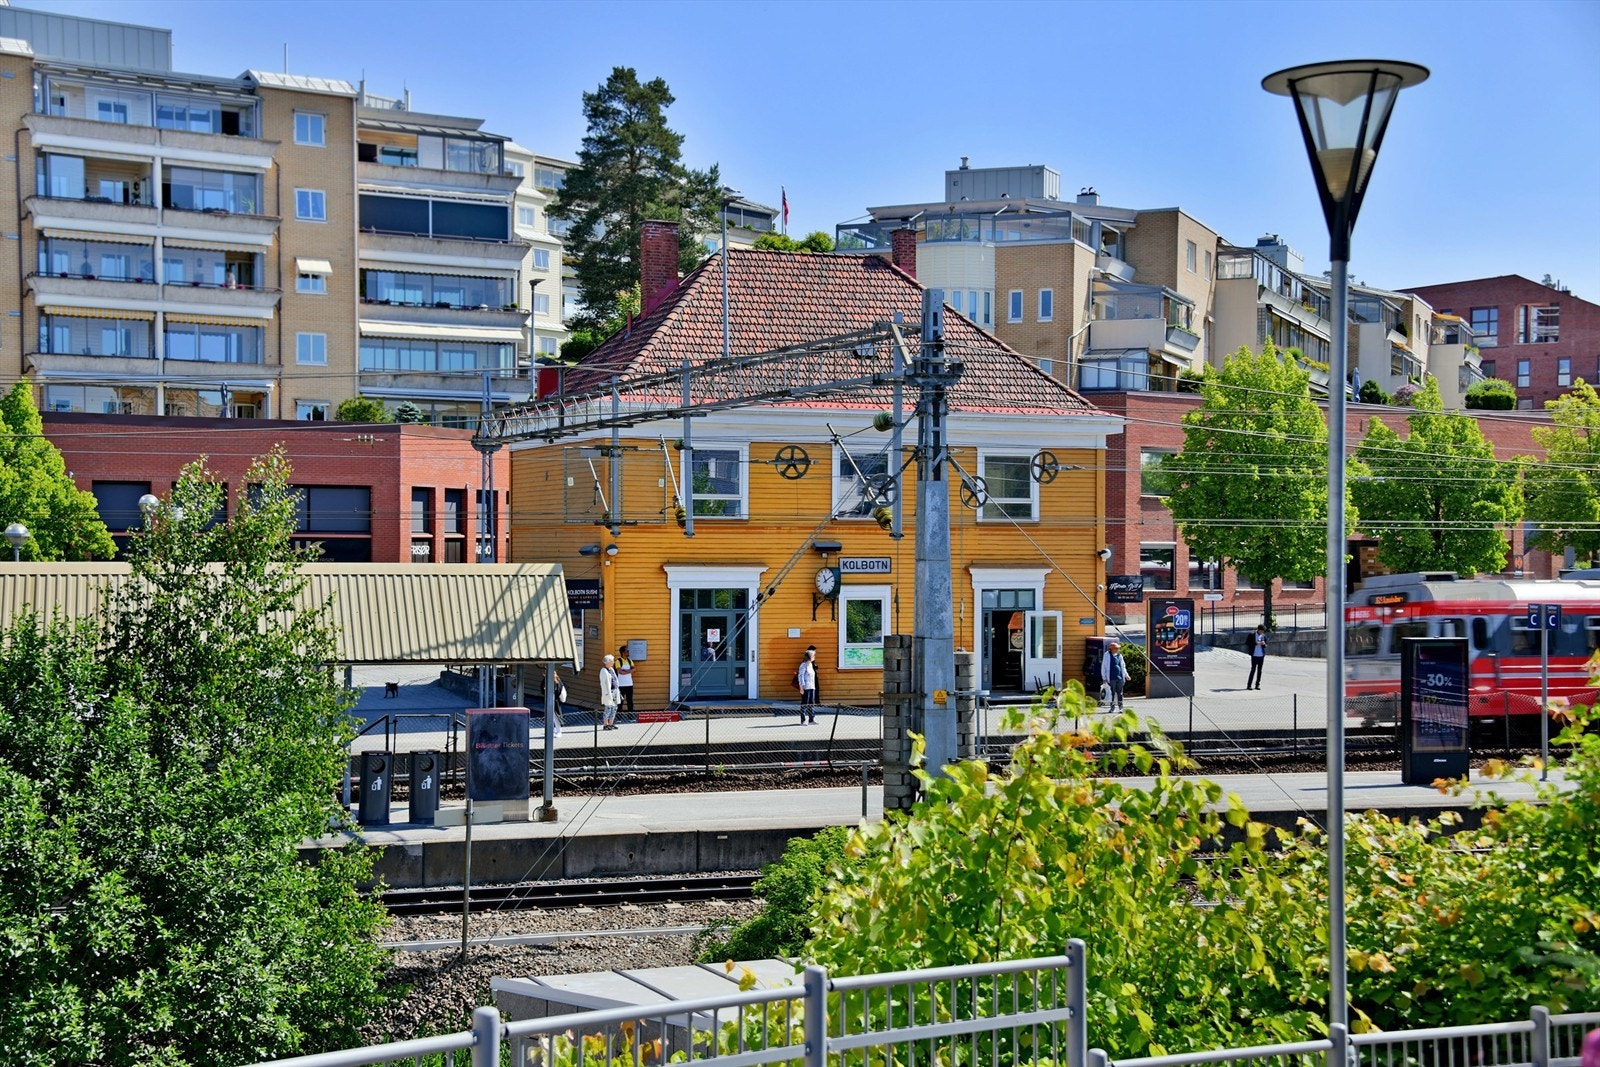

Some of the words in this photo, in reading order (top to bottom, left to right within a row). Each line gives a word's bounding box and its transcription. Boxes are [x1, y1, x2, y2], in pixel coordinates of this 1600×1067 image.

[842, 560, 888, 570] KOLBOTN
[1530, 614, 1537, 626] C
[1548, 614, 1556, 627] C
[502, 741, 524, 749] Tickets
